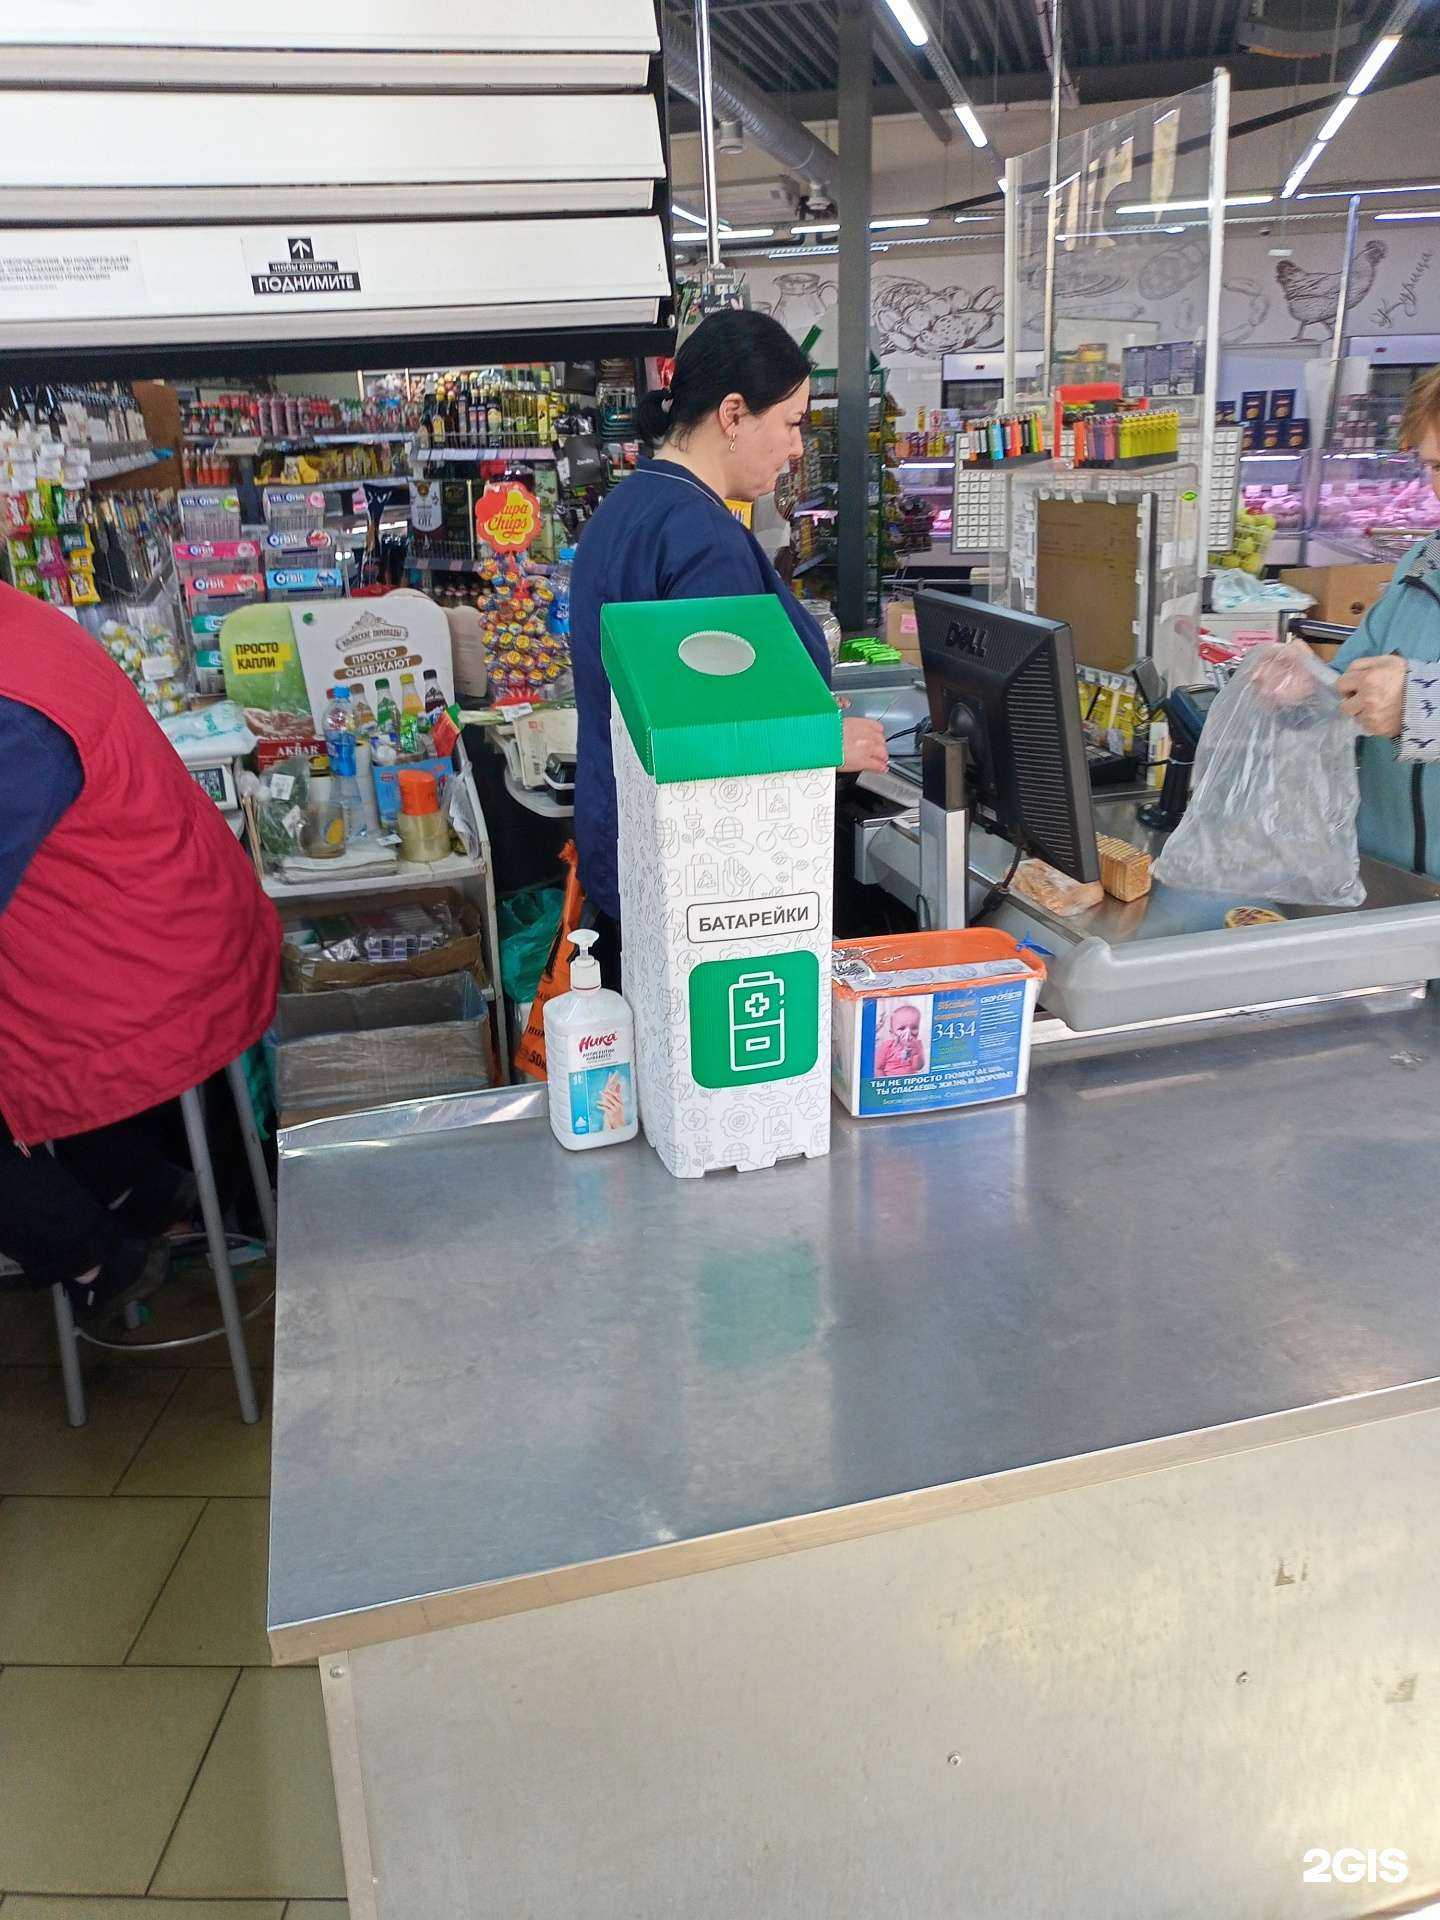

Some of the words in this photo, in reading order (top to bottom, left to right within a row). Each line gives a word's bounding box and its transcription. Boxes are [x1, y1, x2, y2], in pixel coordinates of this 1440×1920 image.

[257, 273, 355, 293] ПОДНИМИТЕ
[268, 533, 297, 548] Orbit
[193, 577, 225, 593] Orbit
[274, 571, 304, 586] Orbit
[945, 622, 988, 657] DELL
[235, 642, 279, 656] ПРОСТО
[351, 648, 398, 664] ПРОСТО
[237, 656, 276, 670] КАПЛИ
[345, 657, 412, 678] ОСВЕЖАЮТ
[276, 744, 319, 758] AKBAR
[699, 905, 809, 932] БАТАРЕЙКИ
[932, 1020, 977, 1042] 3434
[578, 1032, 617, 1053] Ника
[870, 1080, 886, 1088] ТЫ
[888, 1079, 901, 1087] НЕ
[903, 1075, 943, 1086] ПРОСТО
[876, 1087, 889, 1096] ТЫ
[891, 1083, 938, 1095] СПАСАЕШЬ
